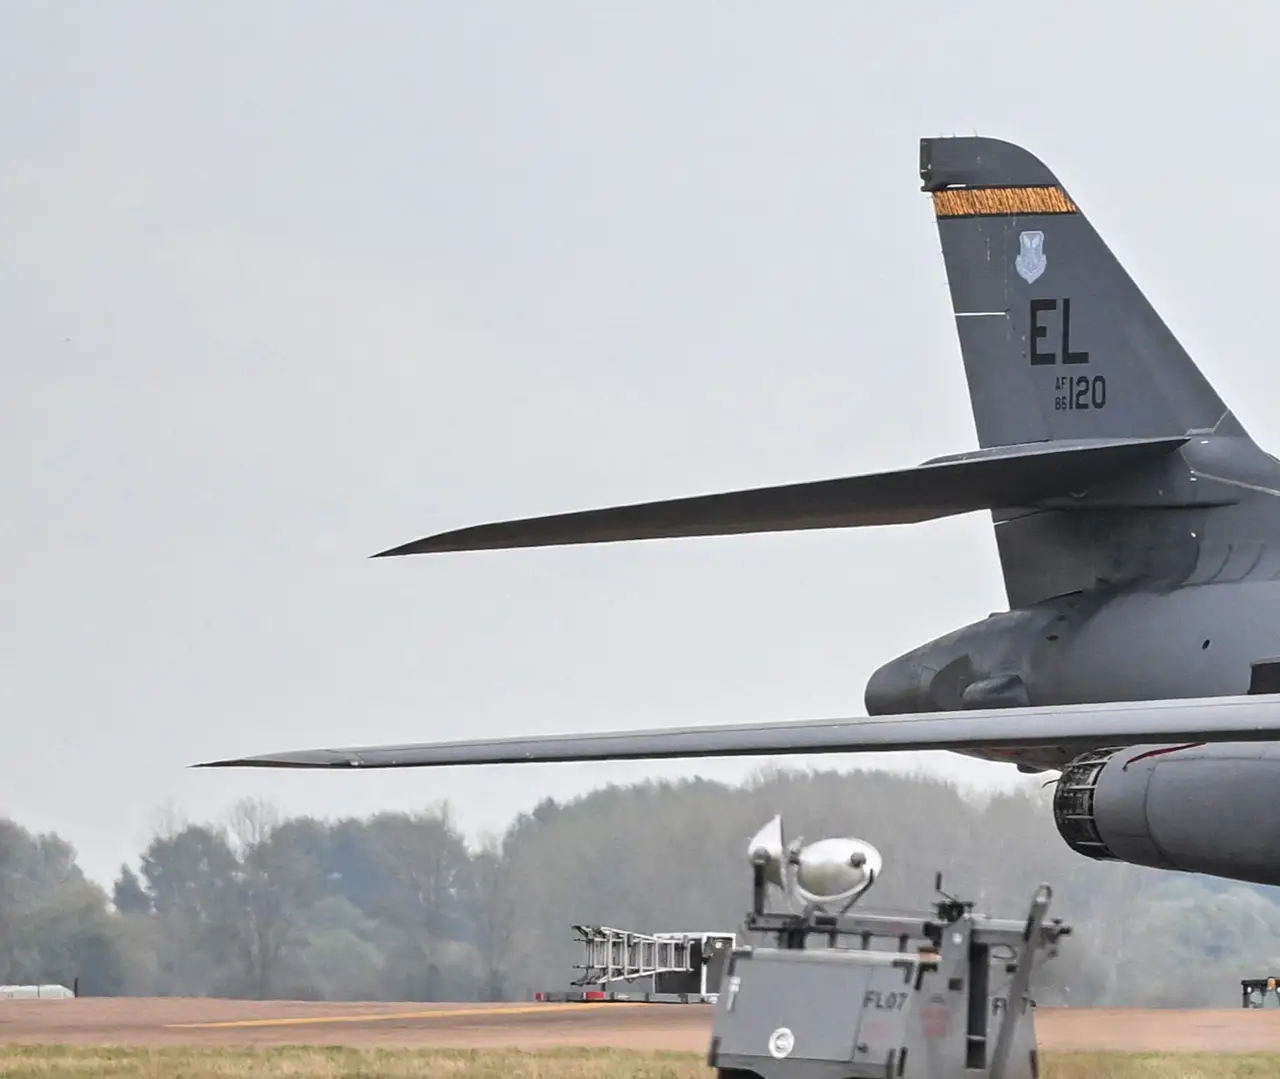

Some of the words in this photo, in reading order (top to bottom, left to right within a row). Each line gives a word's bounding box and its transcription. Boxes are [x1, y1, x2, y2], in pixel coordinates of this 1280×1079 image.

[1030, 299, 1089, 365] EL
[1056, 376, 1068, 391] AF
[1069, 375, 1106, 410] 120
[863, 989, 909, 1012] FL07
